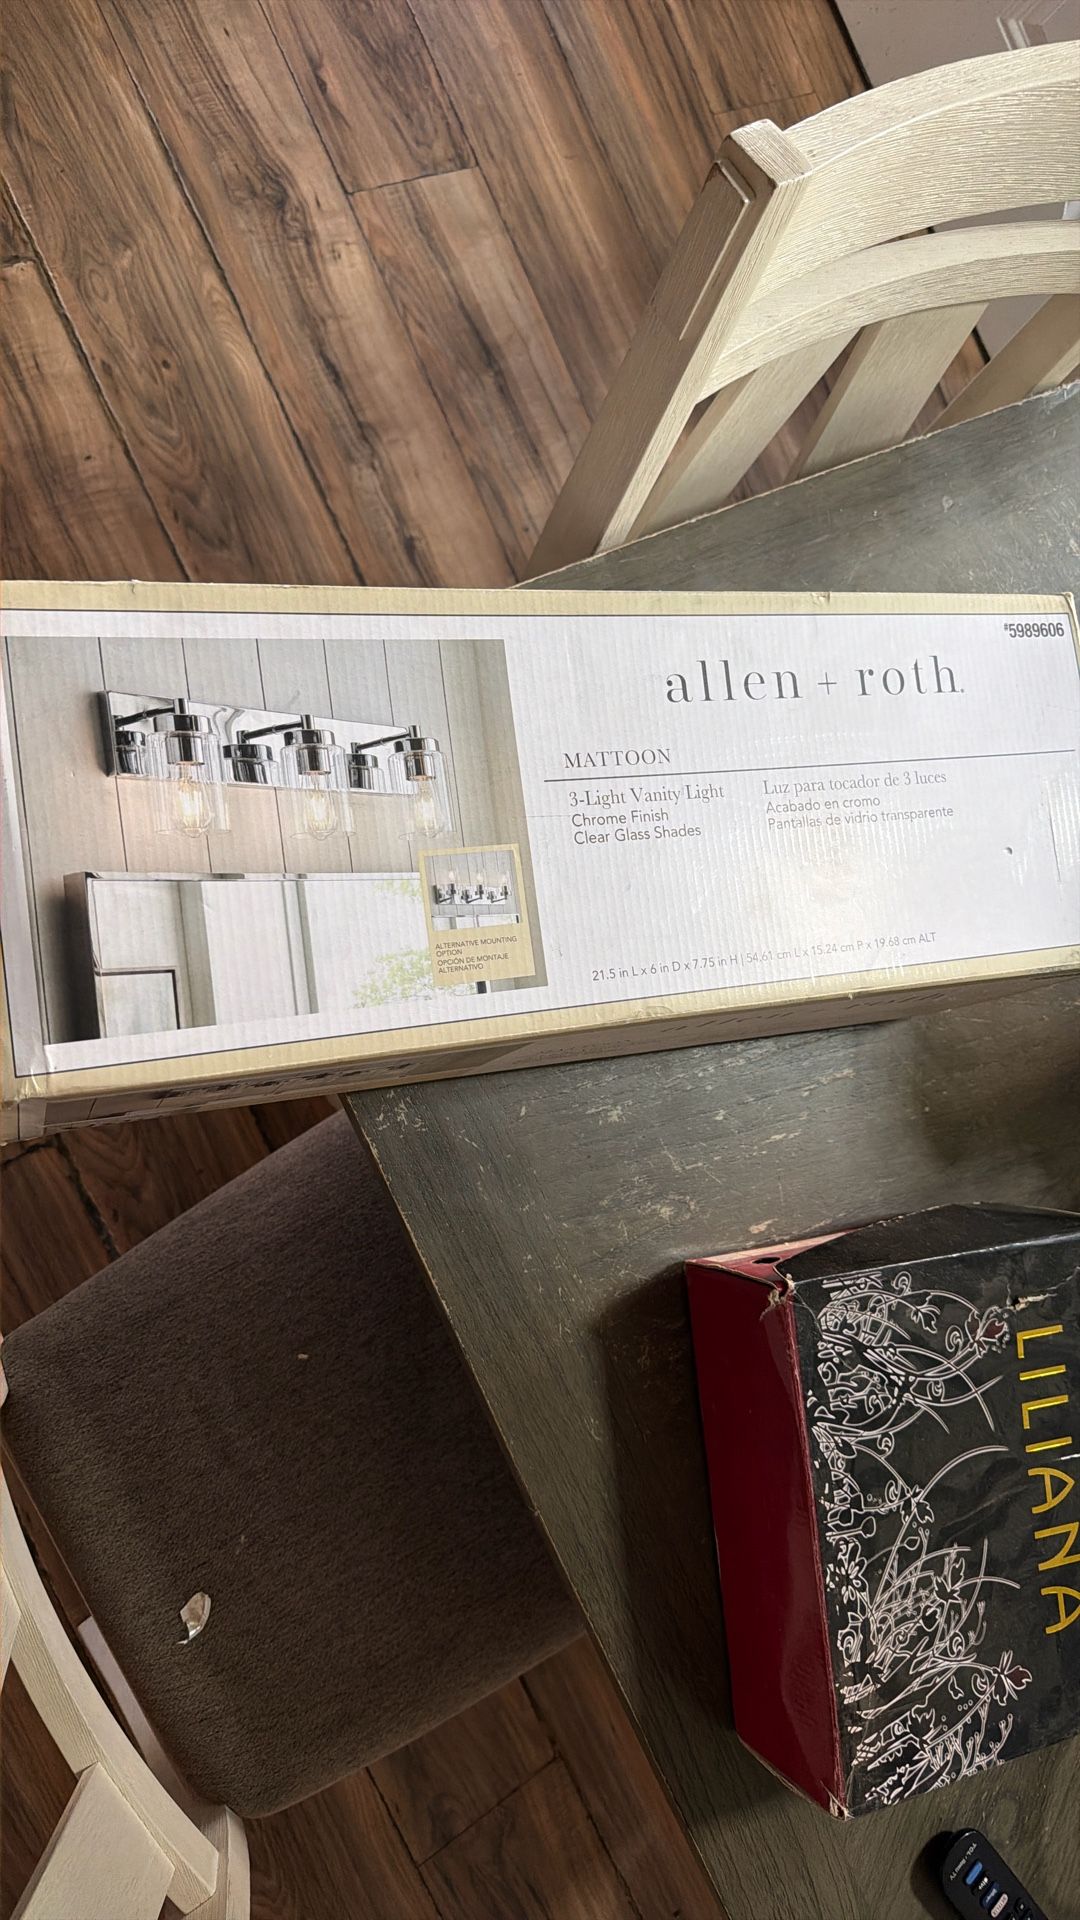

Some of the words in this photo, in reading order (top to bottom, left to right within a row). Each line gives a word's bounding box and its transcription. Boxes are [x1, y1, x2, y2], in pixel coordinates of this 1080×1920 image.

[1003, 622, 1065, 638] #5989606
[666, 659, 804, 703] allen
[817, 671, 837, 695] +
[564, 749, 671, 768] MATTOON
[763, 780, 790, 795] Luz
[794, 780, 825, 797] para
[829, 774, 880, 790] tocador
[884, 772, 900, 787] de
[904, 771, 911, 785] 3
[915, 771, 947, 784] luces
[569, 789, 626, 809] 3-Light
[630, 786, 681, 805] Vanity
[685, 784, 725, 803] Light
[766, 801, 821, 814] Acabado
[825, 801, 839, 809] en
[843, 797, 880, 808] cromo
[572, 813, 627, 827] Chrome
[631, 808, 669, 823] Finish
[768, 816, 822, 830] Pantallas
[825, 814, 841, 826] de
[845, 811, 878, 824] vidrio
[881, 807, 954, 822] transparente
[574, 831, 610, 844] Clear
[615, 828, 651, 842] Glass
[655, 824, 701, 839] Shades
[435, 940, 479, 950] ALTERNATIVE
[480, 936, 517, 945] MOUNTING
[436, 949, 463, 957] OPTION
[476, 953, 509, 961] MONTAJE
[592, 968, 616, 981] 21.5
[619, 968, 629, 978] in
[632, 966, 638, 976] L
[641, 967, 647, 975] x
[650, 964, 657, 974] 6
[660, 963, 669, 973] in
[672, 961, 681, 972] D
[684, 962, 691, 970] x
[692, 957, 715, 969] 7.75
[718, 956, 727, 966] in
[730, 954, 737, 965] H
[746, 951, 773, 963] 54.61
[776, 951, 792, 960] cm
[795, 948, 801, 958] L
[803, 948, 809, 957] x
[811, 944, 837, 955] 15.24
[840, 944, 855, 953] cm
[857, 940, 864, 950] P
[866, 941, 872, 949] x
[874, 937, 900, 948] 19.68
[902, 936, 916, 945] cm
[918, 932, 937, 943] ALT
[438, 963, 484, 974] ALTERNATIVO
[1016, 1324, 1080, 1635] LILIANA
